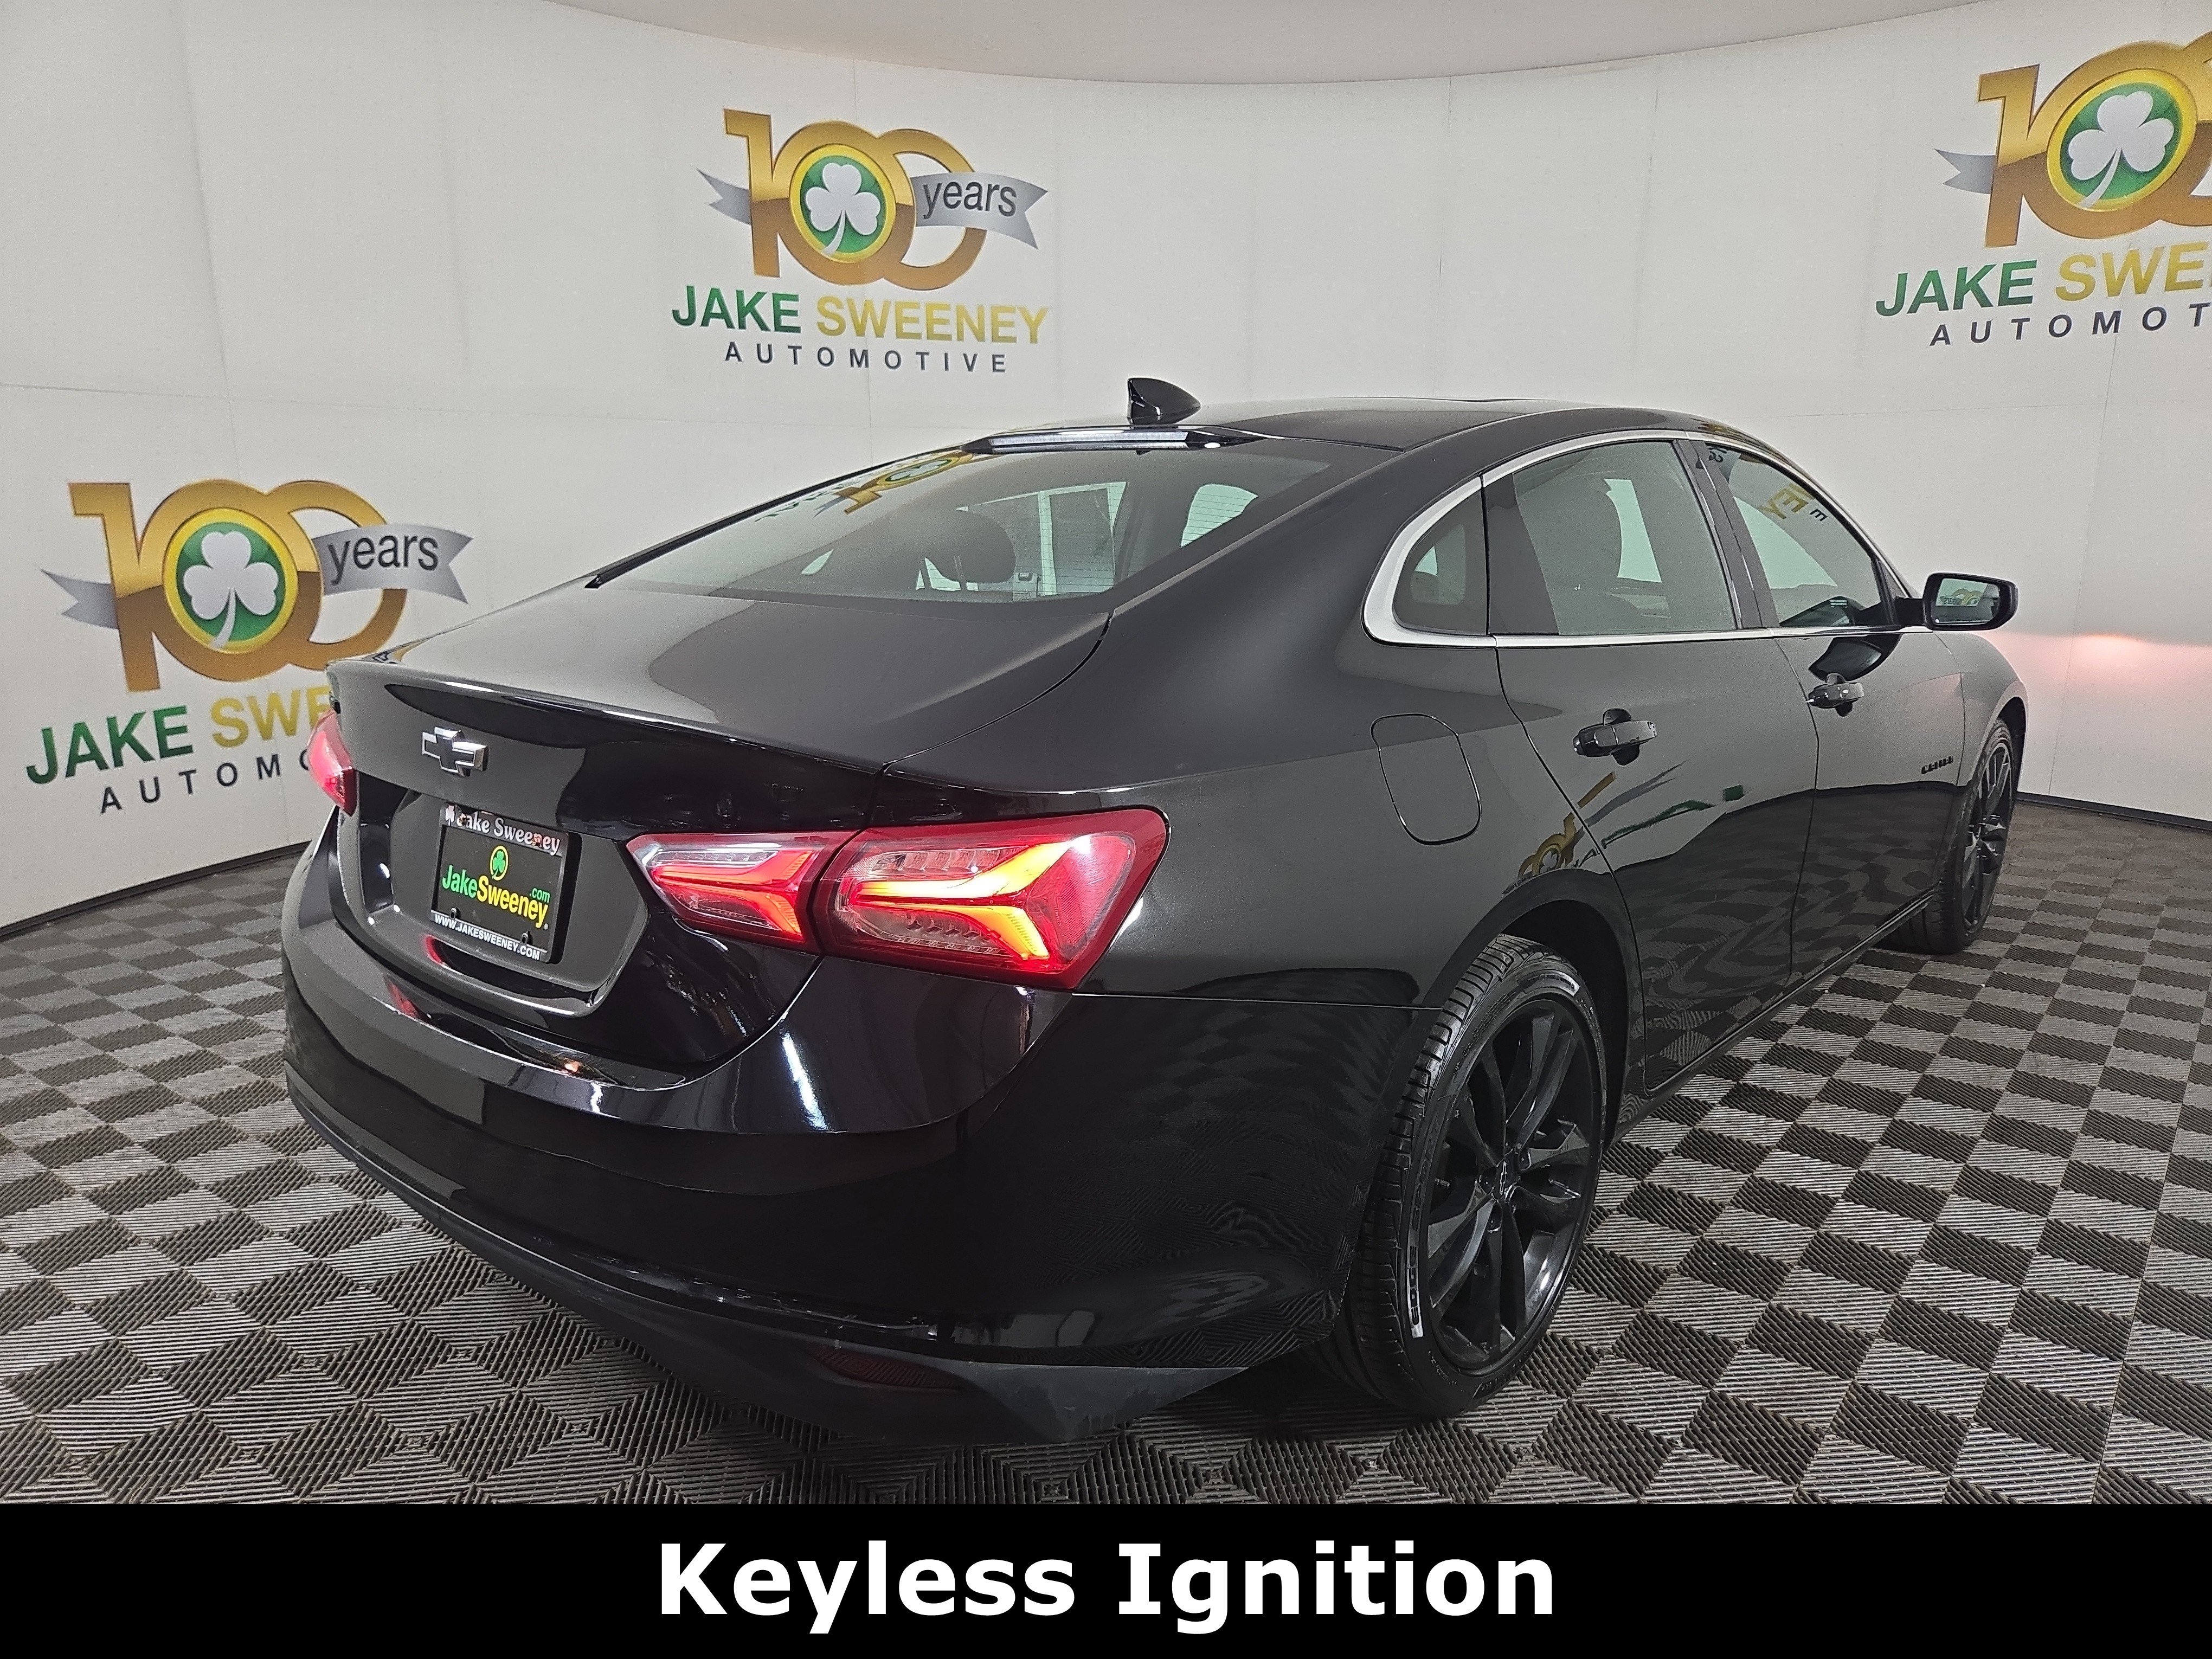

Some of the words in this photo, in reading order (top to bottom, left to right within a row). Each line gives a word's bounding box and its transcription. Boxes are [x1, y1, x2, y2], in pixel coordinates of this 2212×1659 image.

[923, 181, 1018, 219] years
[1876, 260, 2037, 317] JAKE
[2055, 241, 2212, 301] SWE
[672, 285, 801, 334] JAKE
[816, 296, 1048, 344] SWEENEY
[725, 342, 1006, 372] AUTOMOTIVE
[328, 533, 439, 586] years
[26, 705, 194, 785] JAKE
[494, 818, 561, 856] Sweeney
[529, 887, 550, 903] .com
[435, 914, 541, 961] WWW.JAKESWEENEY.COM
